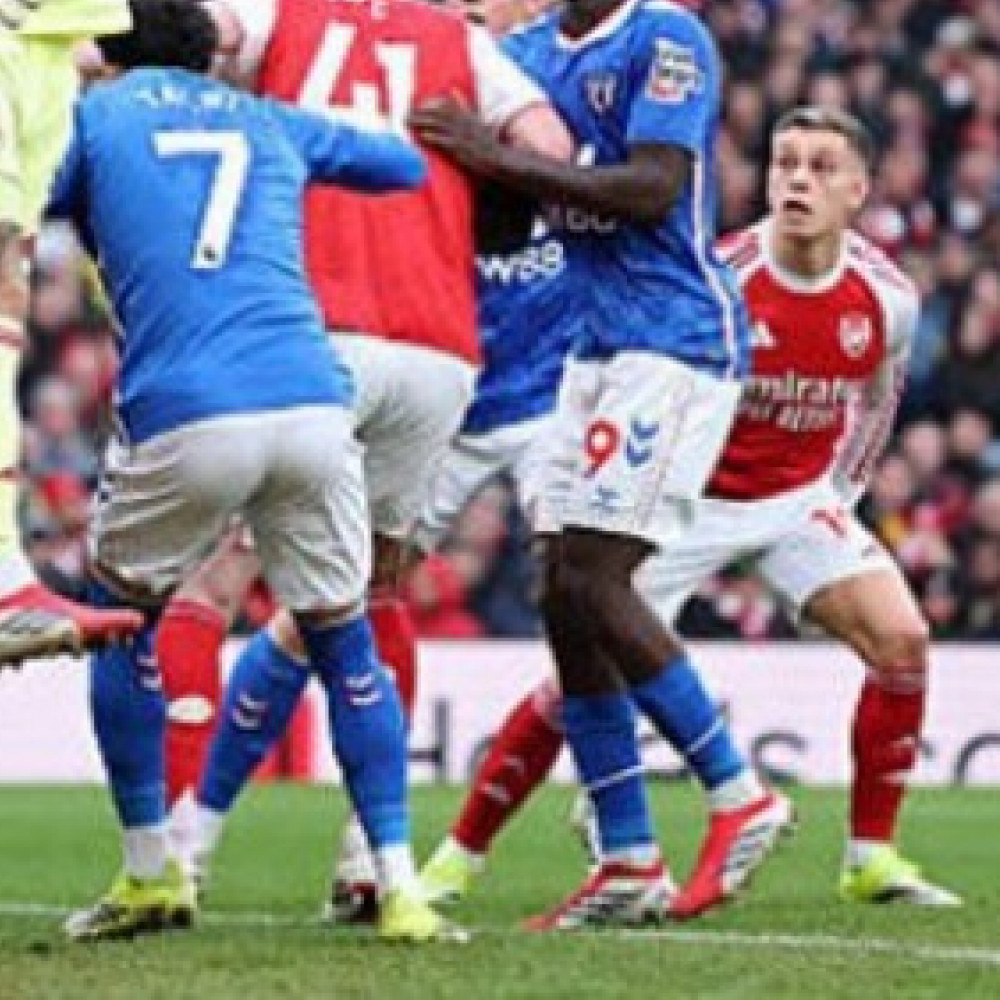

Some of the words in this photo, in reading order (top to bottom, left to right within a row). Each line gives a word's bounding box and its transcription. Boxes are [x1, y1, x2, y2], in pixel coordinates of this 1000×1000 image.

[296, 18, 418, 138] 41
[152, 130, 252, 270] 7
[581, 416, 622, 478] 9
